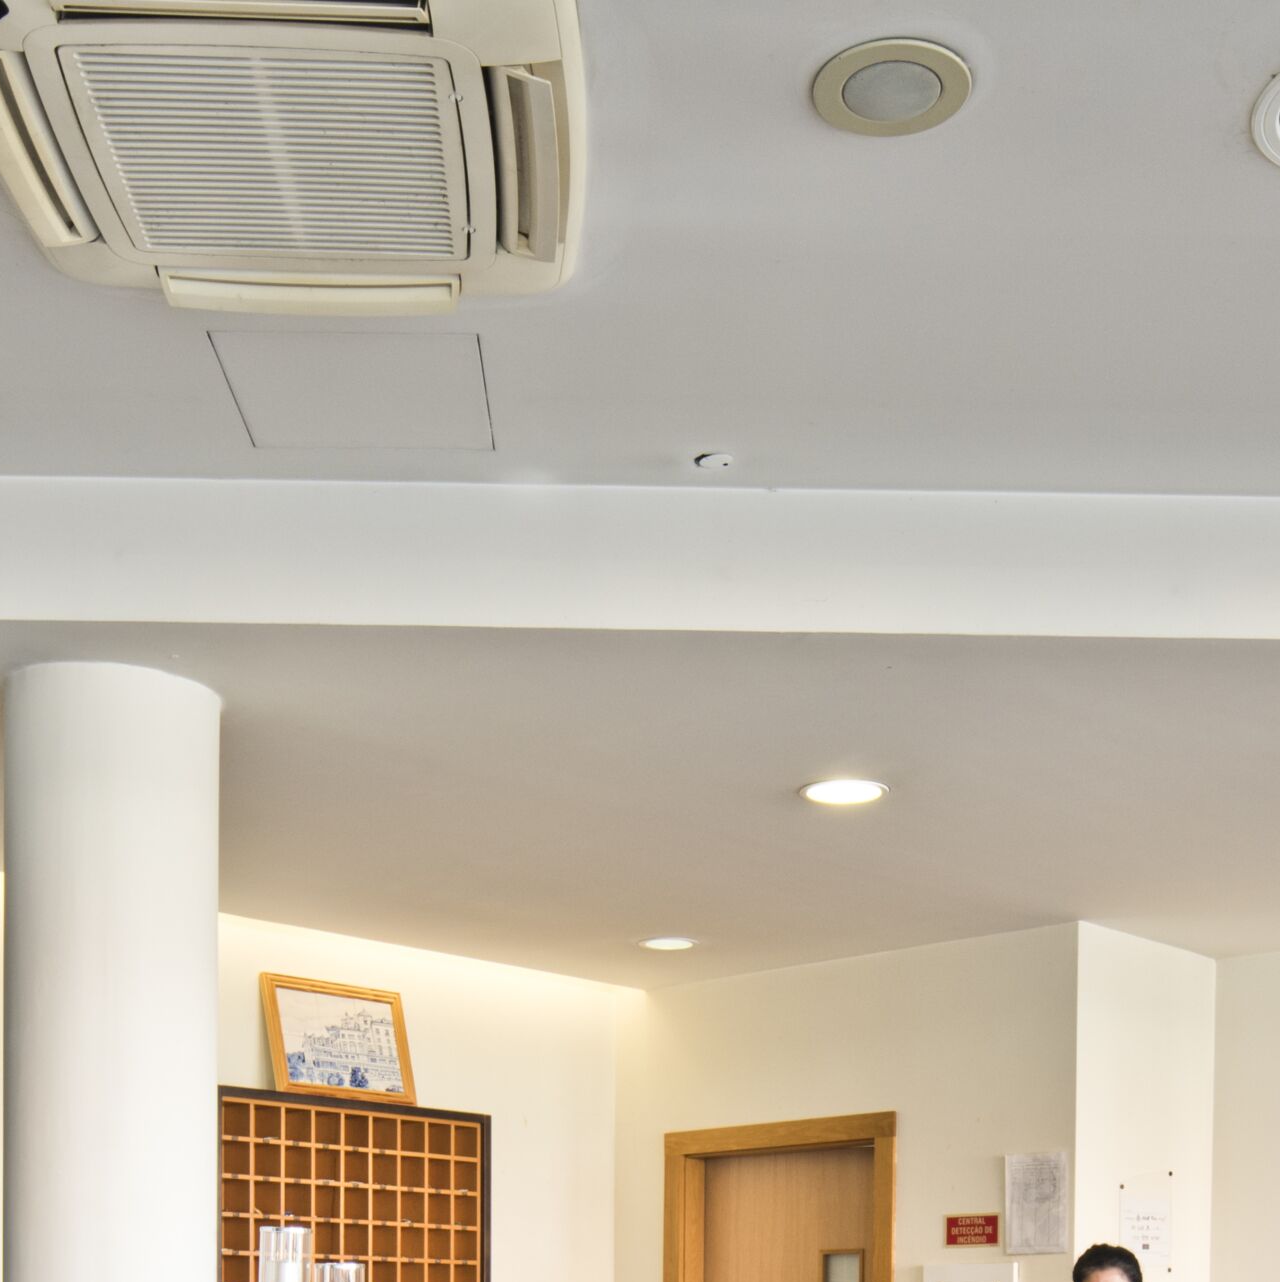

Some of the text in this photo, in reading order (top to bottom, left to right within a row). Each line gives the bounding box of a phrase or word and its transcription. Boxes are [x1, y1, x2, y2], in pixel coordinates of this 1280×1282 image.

[958, 1216, 986, 1226] CENTRAL
[951, 1225, 993, 1235] DETECÇÃO DE
[956, 1235, 987, 1244] INCÊNDIO
